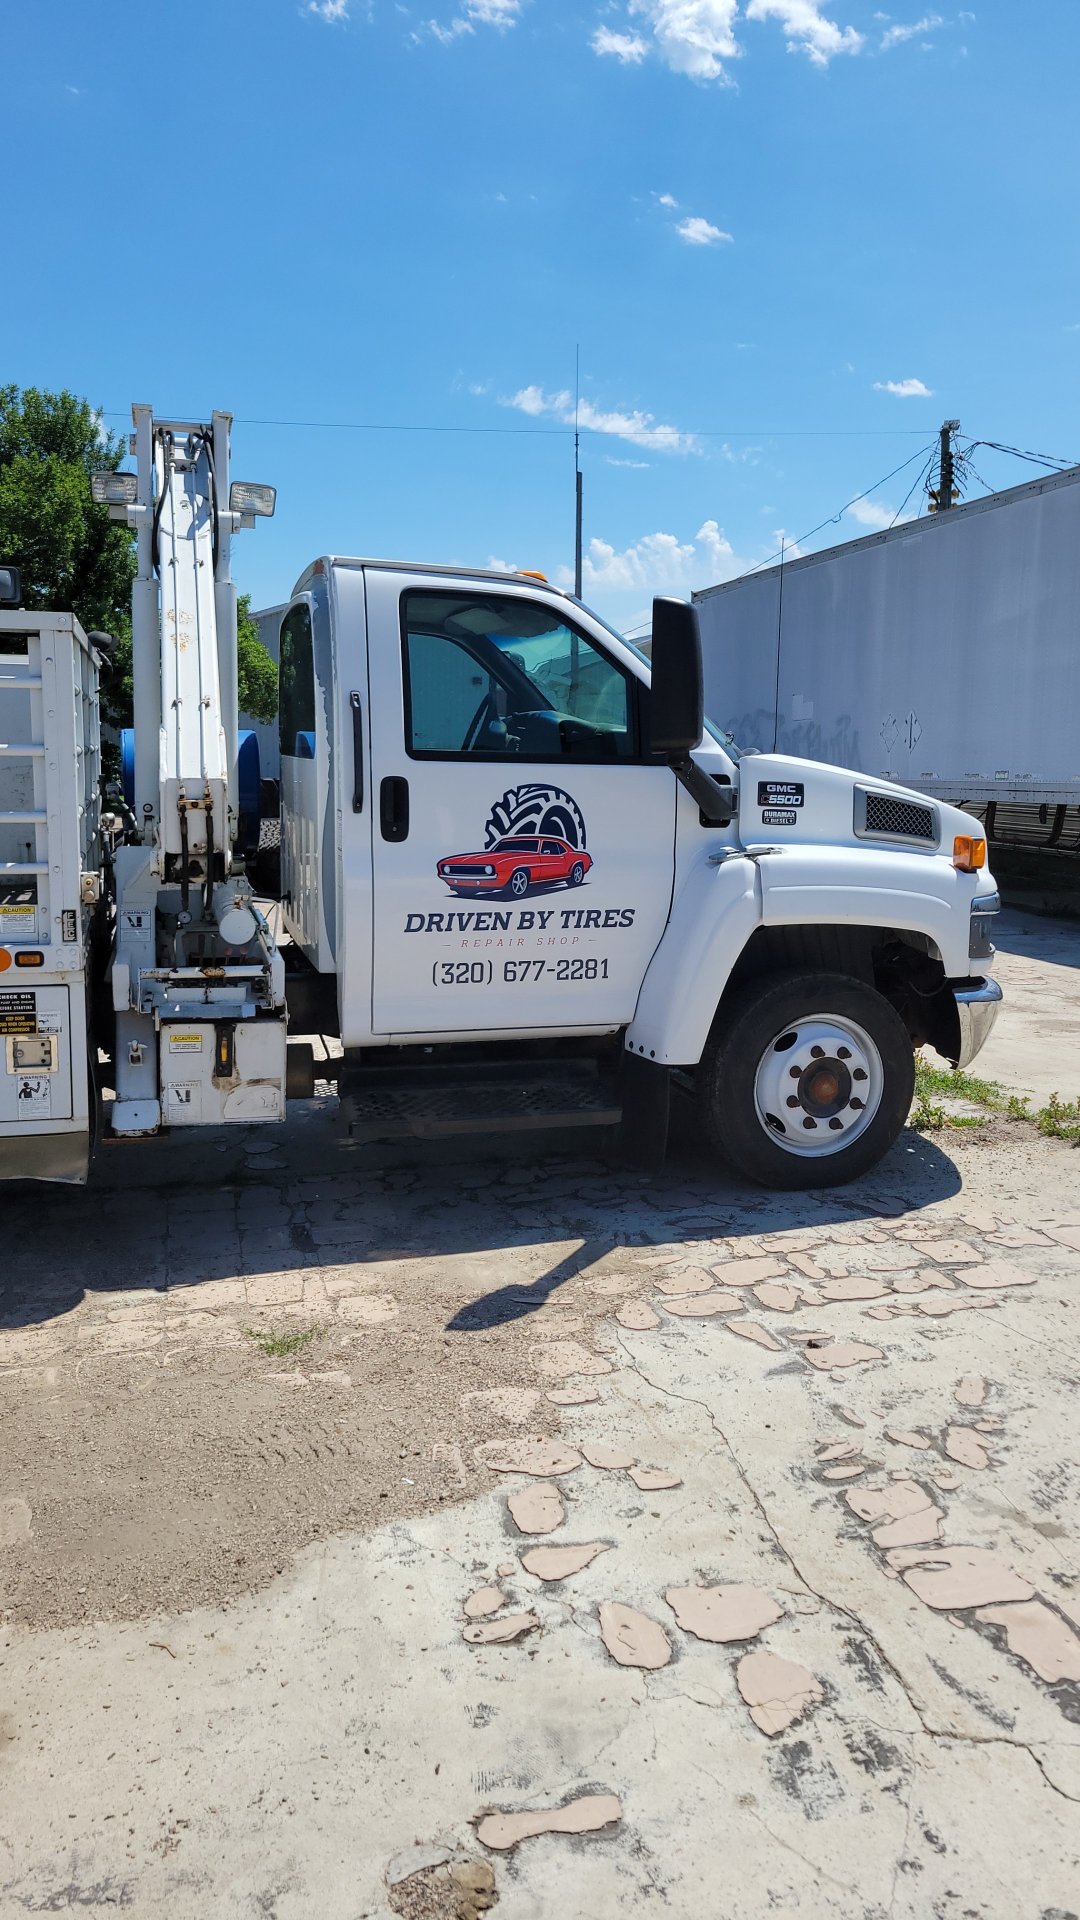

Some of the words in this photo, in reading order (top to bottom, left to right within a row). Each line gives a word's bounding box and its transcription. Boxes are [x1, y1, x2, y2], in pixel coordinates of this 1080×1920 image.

[761, 795, 801, 804] C5500
[403, 912, 512, 933] DRIVEN
[517, 910, 555, 930] BY
[560, 908, 635, 929] TIRES
[461, 938, 525, 948] REPAIR
[536, 936, 579, 946] SHOP
[432, 959, 494, 986] (320)
[503, 958, 609, 982] 677-2281
